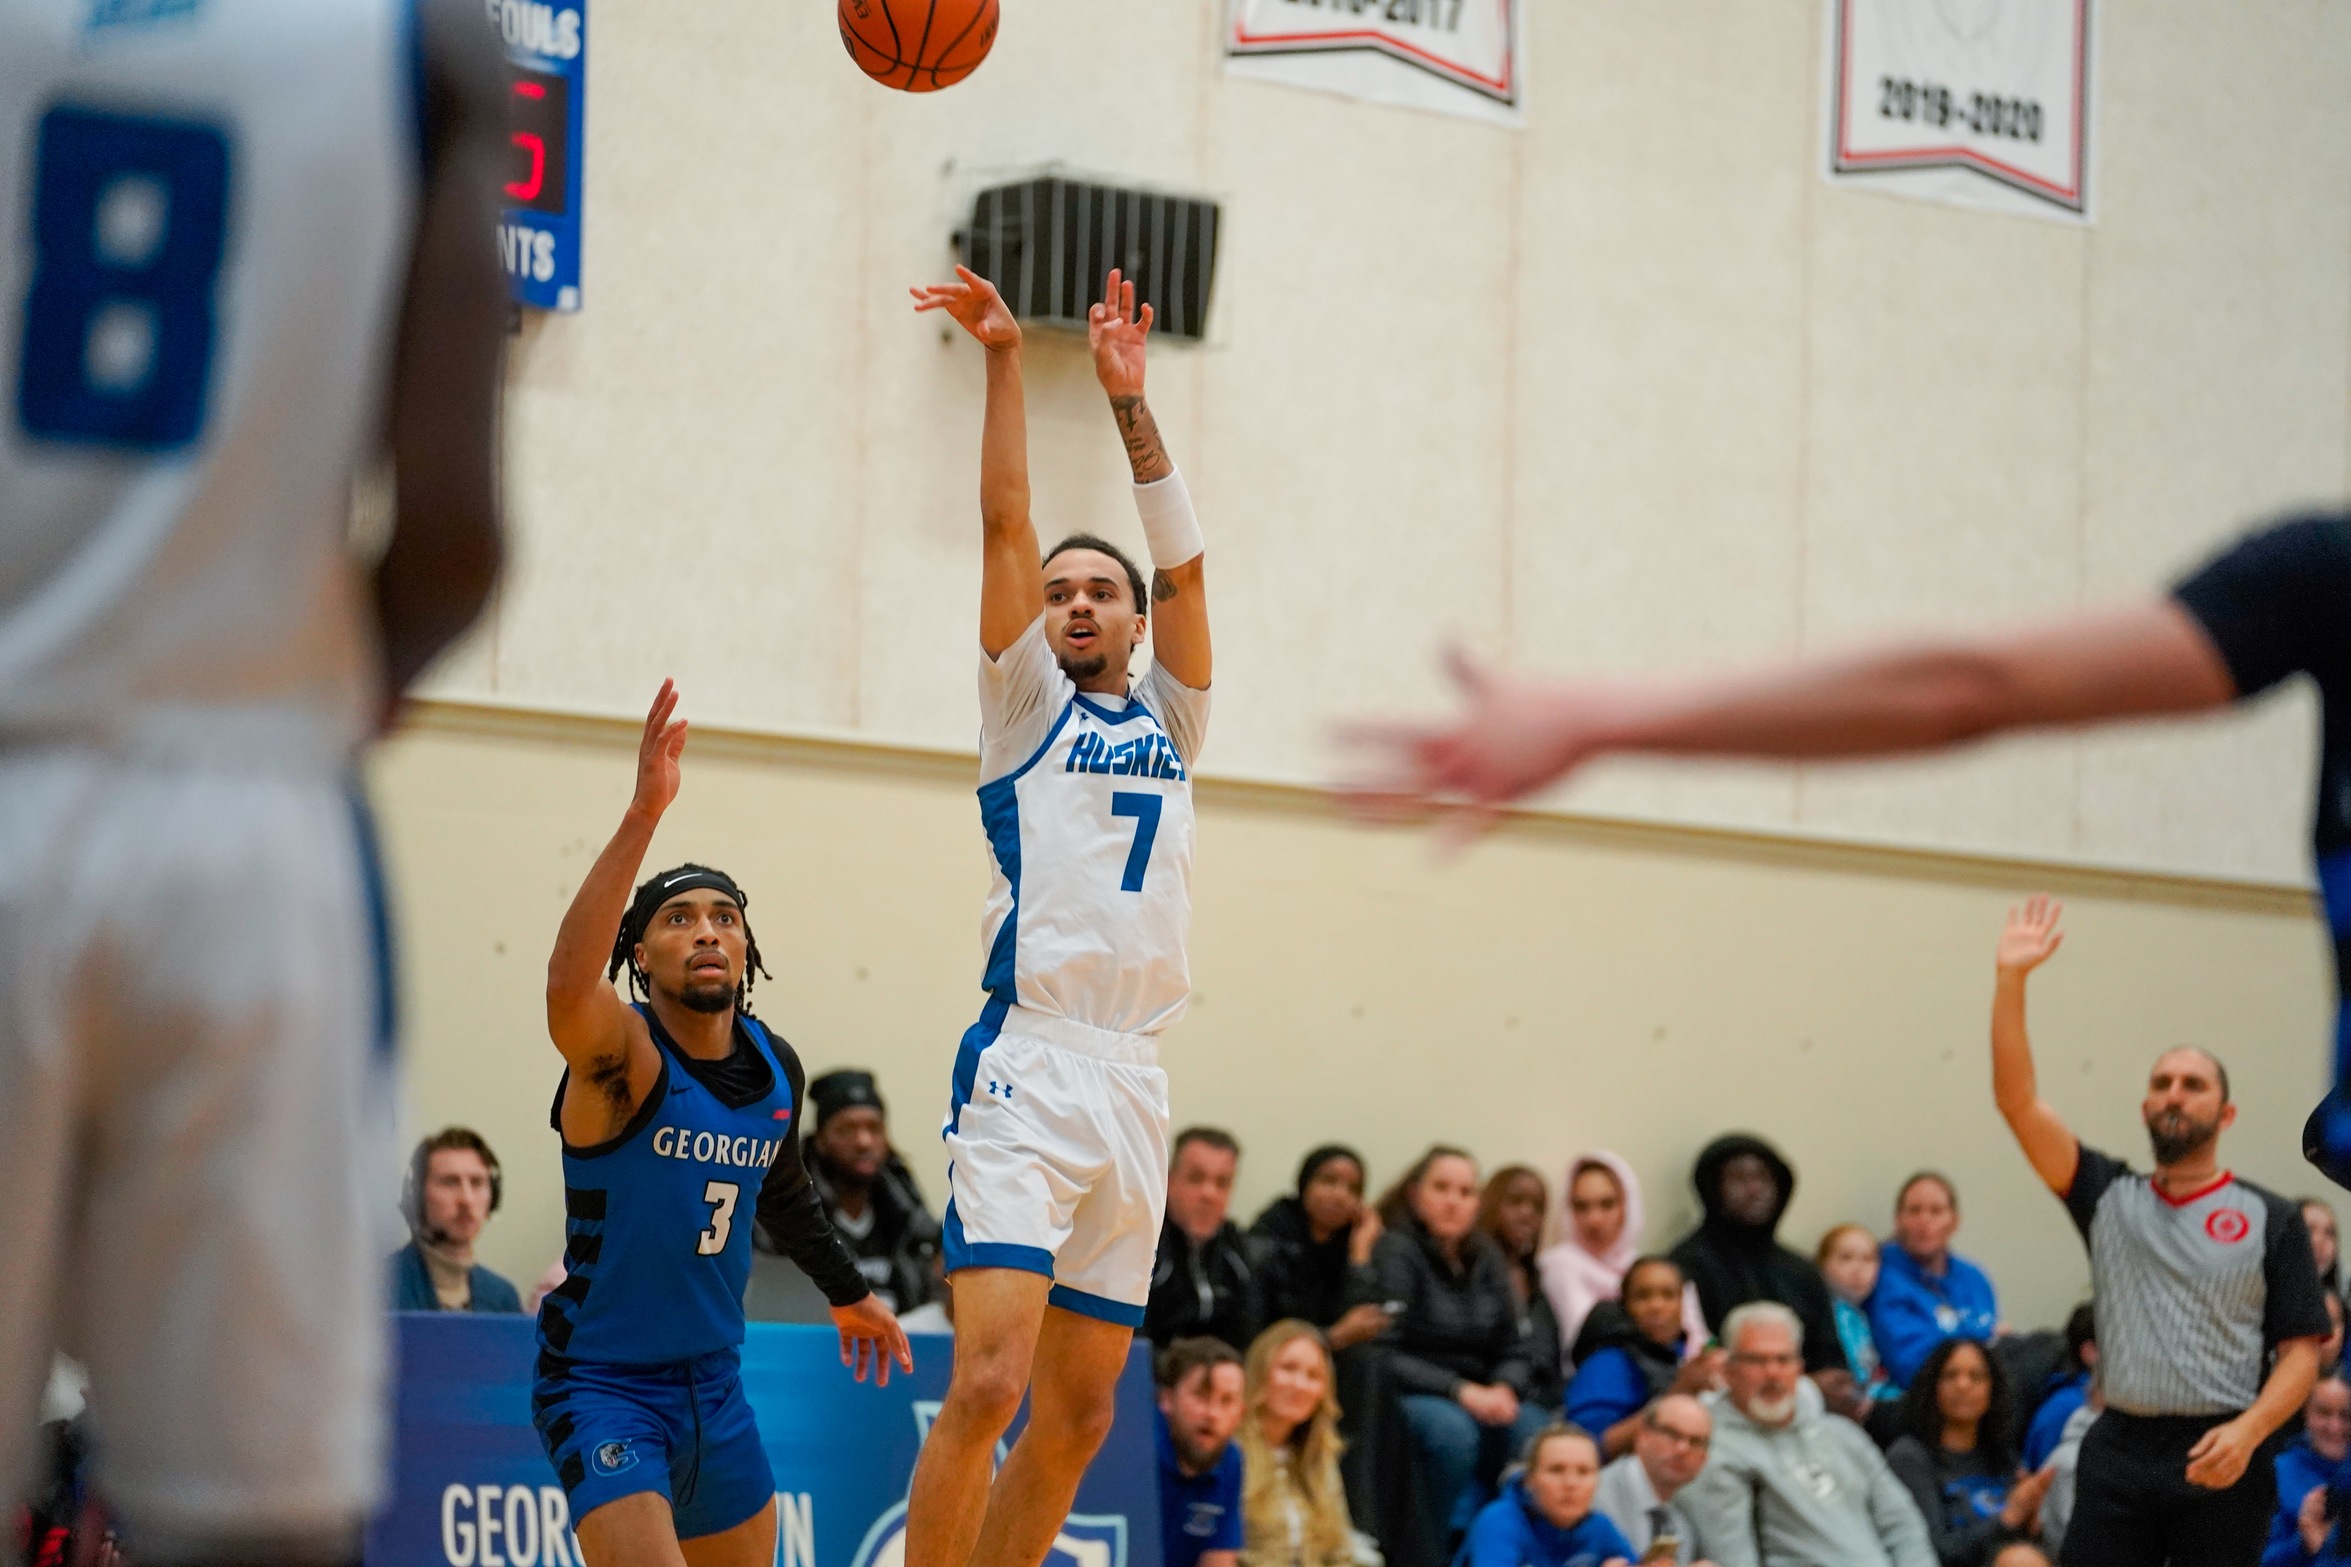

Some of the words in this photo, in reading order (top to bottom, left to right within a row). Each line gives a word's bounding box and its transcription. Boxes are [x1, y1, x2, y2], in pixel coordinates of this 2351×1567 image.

[18, 104, 233, 449] 8
[494, 223, 556, 282] NTS
[1111, 791, 1163, 893] 7
[695, 1180, 739, 1256] 3
[441, 1482, 588, 1567] GEOR
